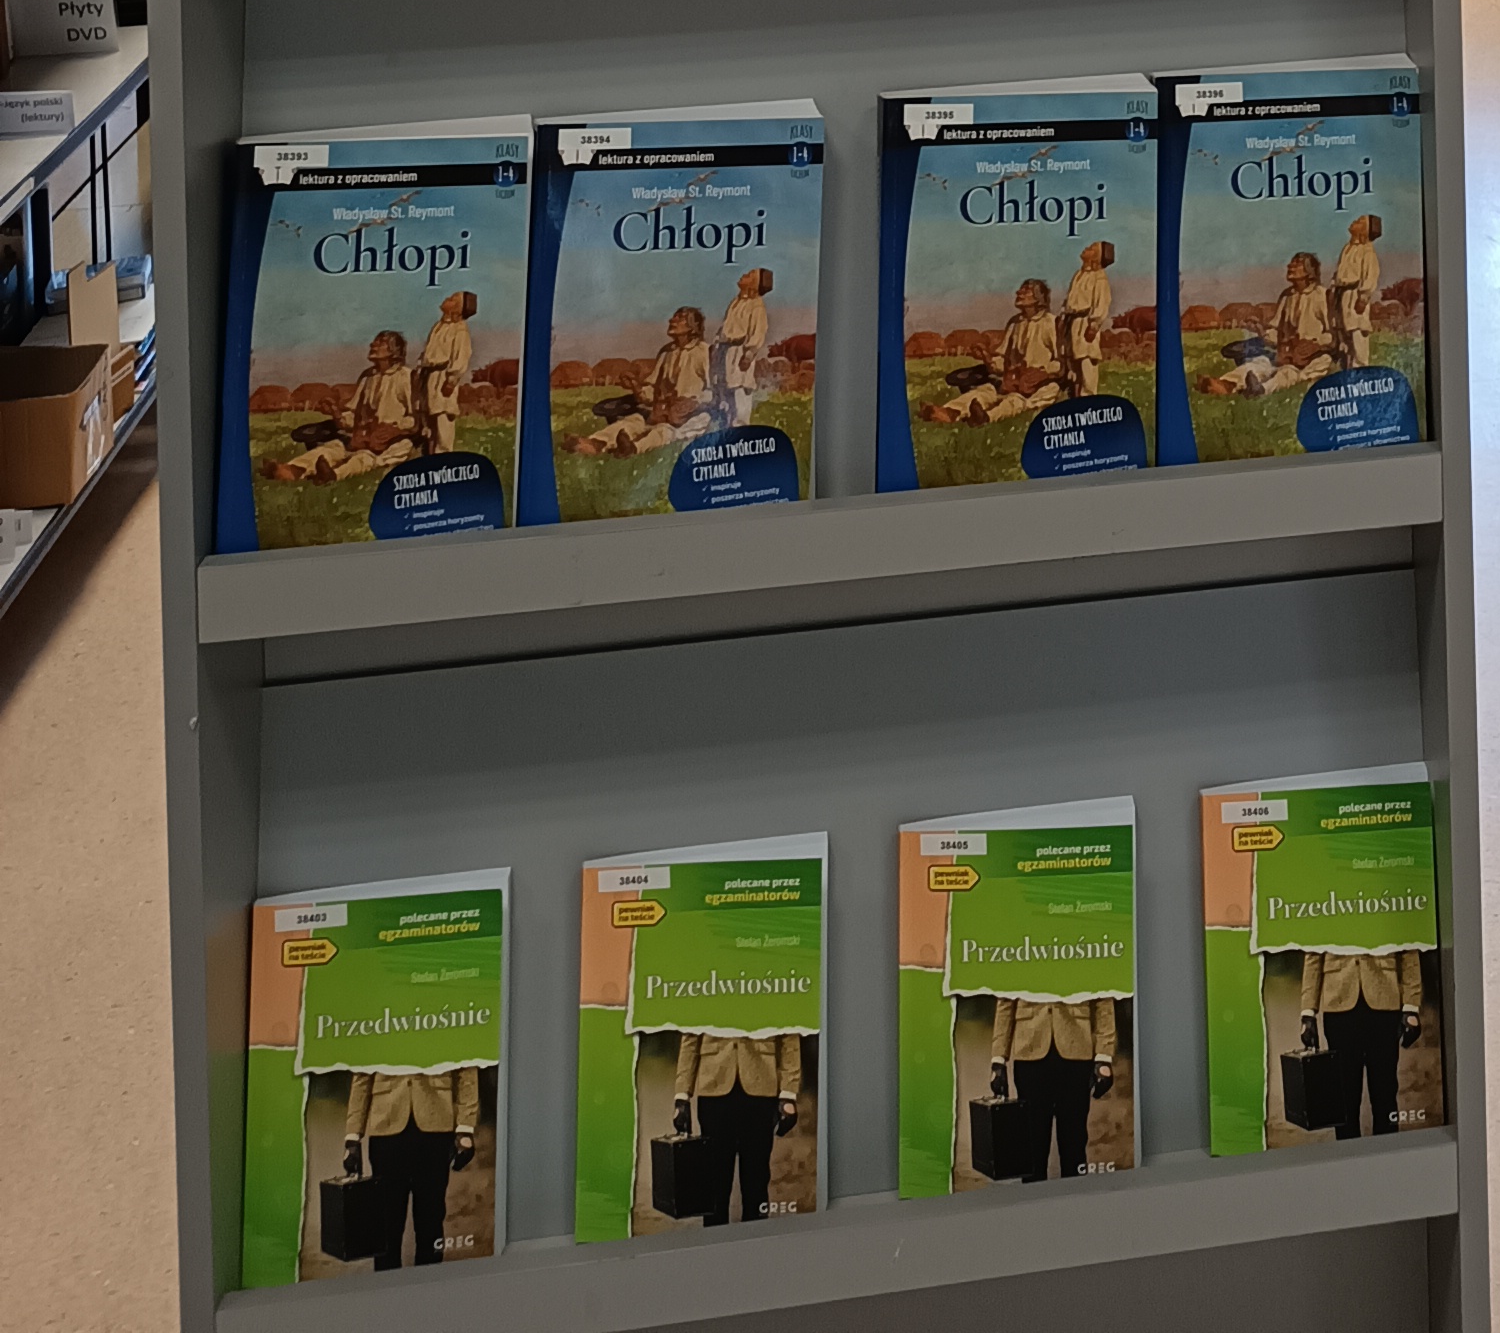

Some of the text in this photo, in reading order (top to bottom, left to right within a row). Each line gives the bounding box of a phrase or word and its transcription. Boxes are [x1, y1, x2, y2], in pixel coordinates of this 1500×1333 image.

[58, 0, 104, 18] Płyty
[66, 26, 107, 42] DVD
[925, 110, 954, 120] 38395
[580, 135, 610, 144] 38394
[276, 152, 308, 161] 38393
[599, 151, 714, 165] lektura z opracowaniem
[1231, 153, 1374, 213] Chłopi
[632, 184, 751, 201] Władysław St. Reymont
[333, 207, 388, 221] Władysław
[408, 205, 454, 220] Reymont
[960, 179, 1107, 238] Chłopi
[613, 206, 767, 266] Chłopi
[313, 226, 471, 288] Chłopi
[691, 437, 776, 465] SZKOŁA TWÓRCZEGO
[692, 462, 736, 482] CZYTANIA
[1241, 807, 1269, 817] 38406
[1339, 800, 1411, 815] polecane przez
[1320, 812, 1412, 830] egzaminatorów
[940, 840, 968, 850] 38405
[1036, 844, 1111, 857] polecane przez
[1017, 855, 1111, 872] egzaminatorów
[619, 874, 648, 885] 38404
[1267, 888, 1428, 920] Przedwiośnie
[399, 908, 480, 926] polecane przez
[379, 920, 480, 942] egzaminatorów
[961, 934, 1124, 963] Przedwiośnie
[645, 969, 811, 999] Przedwiośnie
[316, 1002, 491, 1039] Przedwiośnie
[1388, 1109, 1426, 1123] GREG
[1077, 1161, 1116, 1175] GREG
[759, 1202, 798, 1214] GREG
[433, 1234, 475, 1251] GREG
